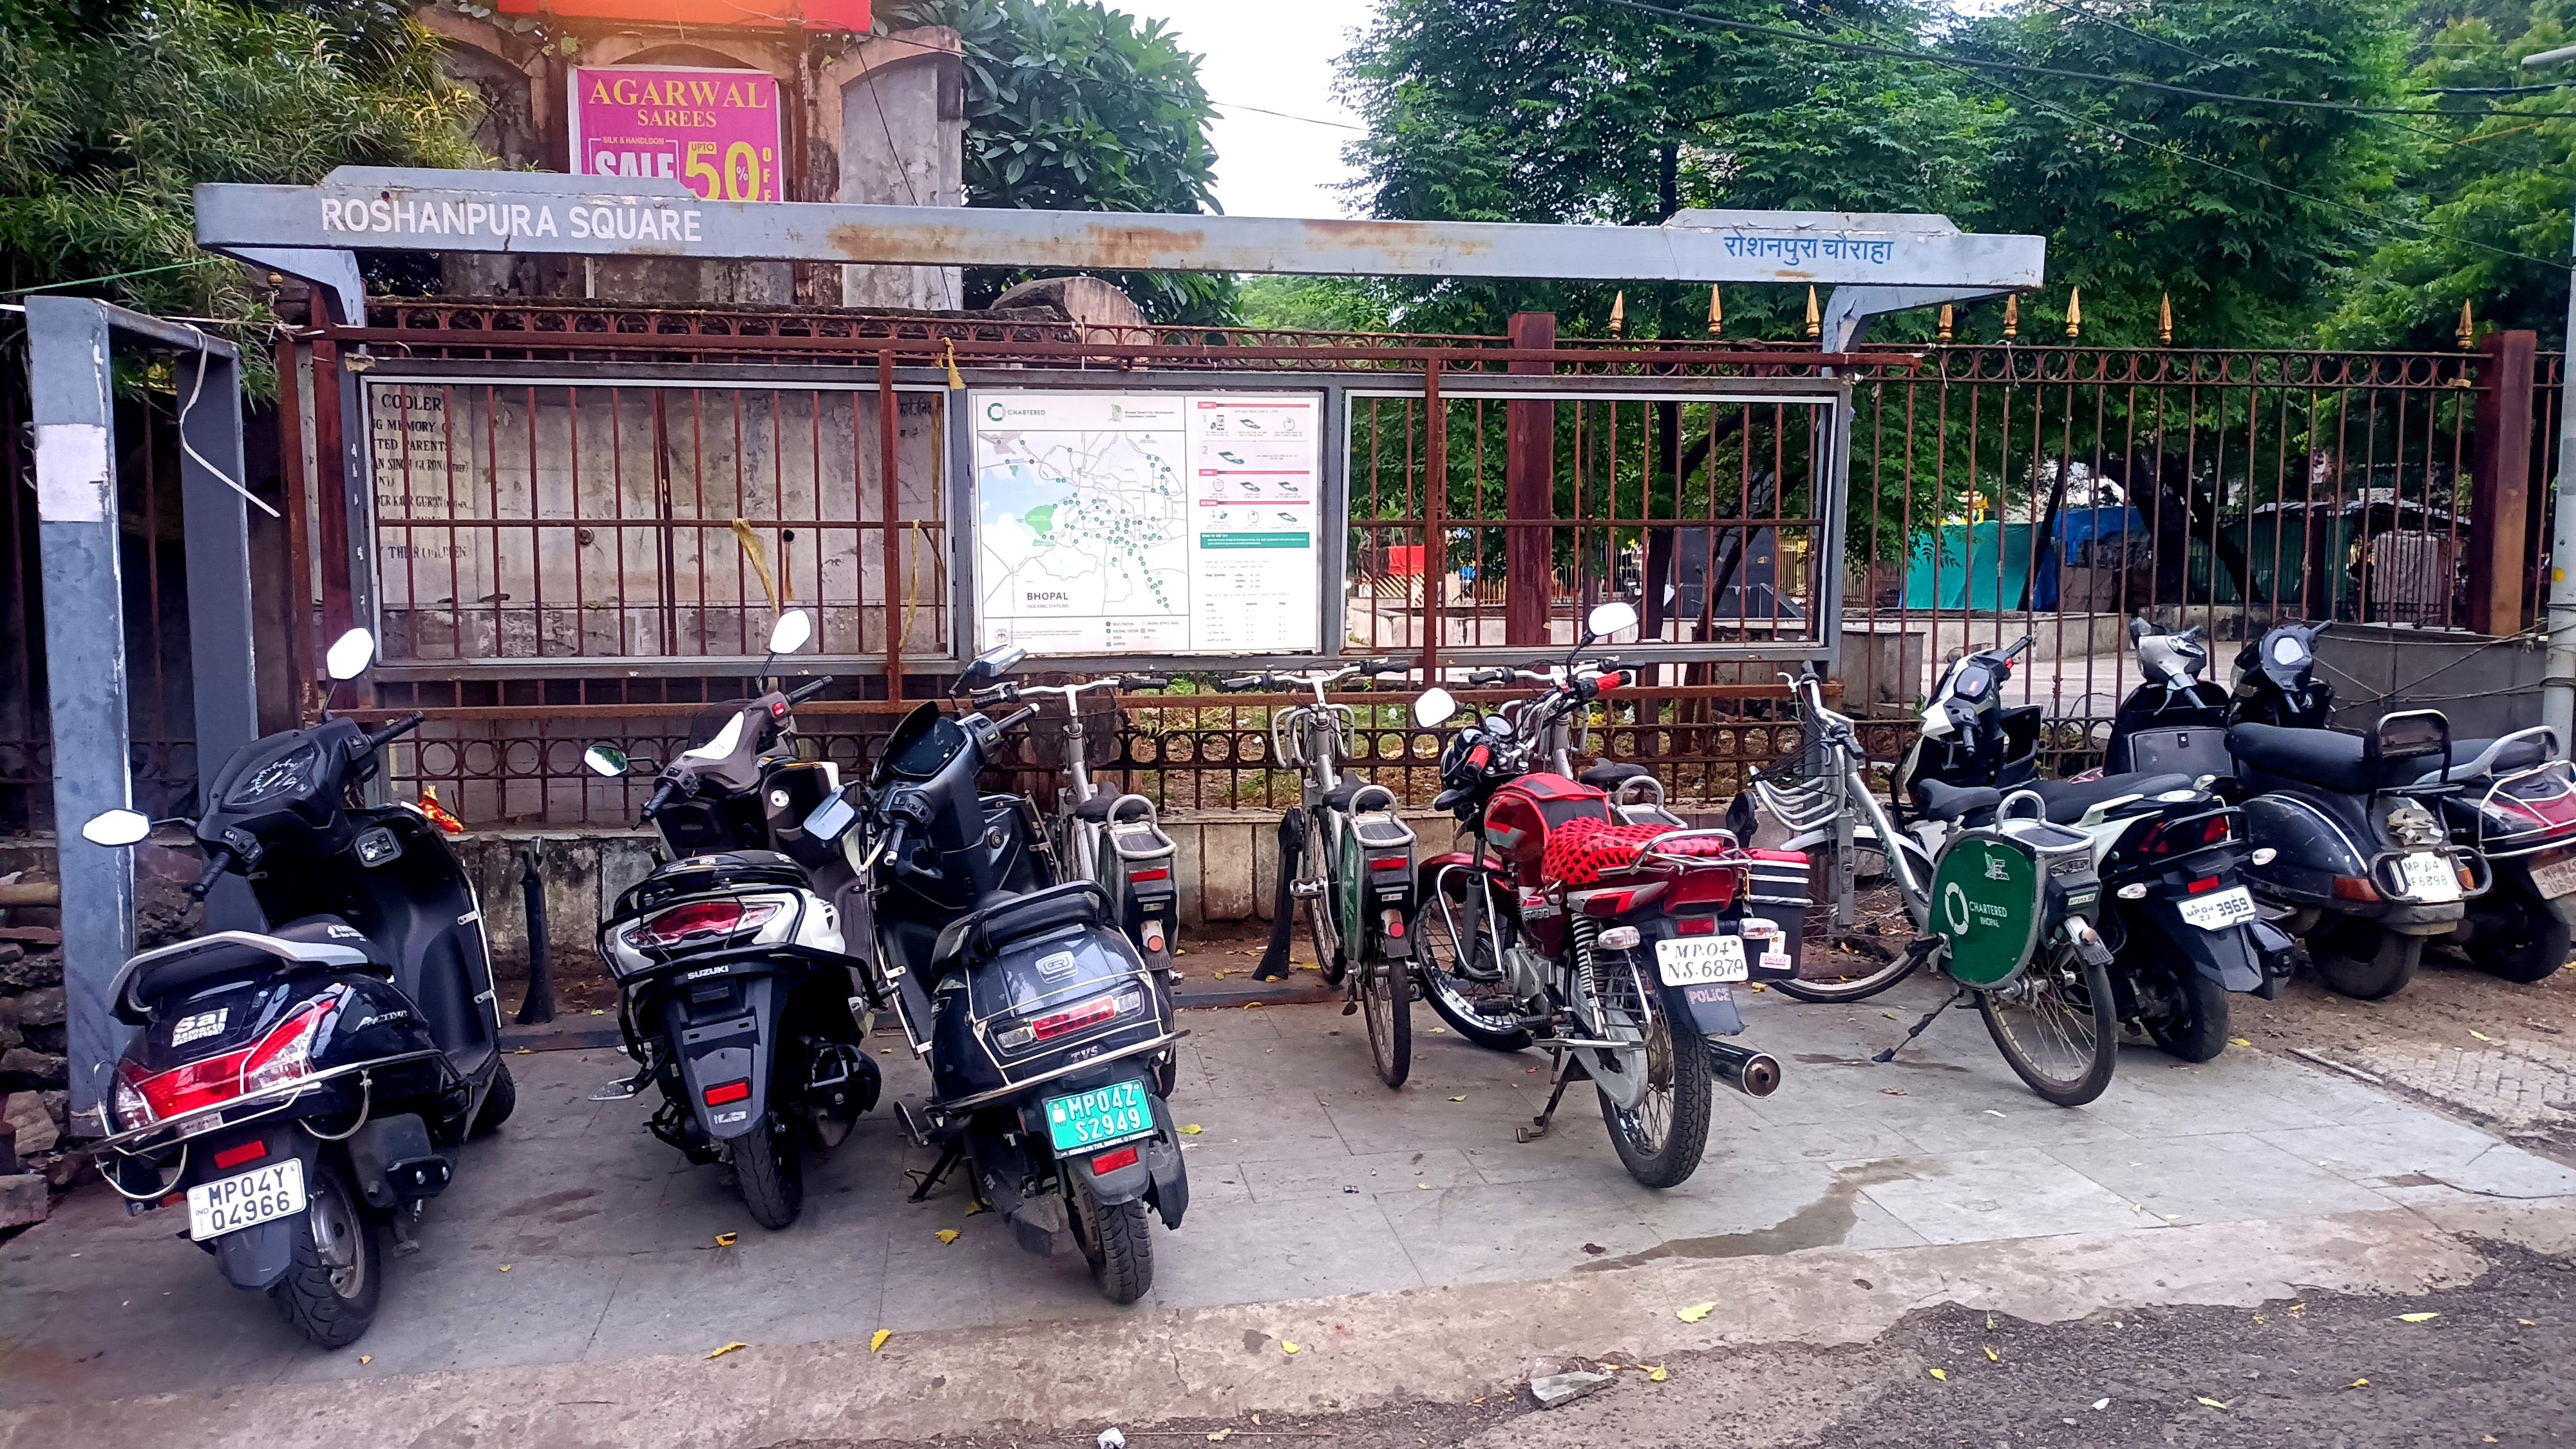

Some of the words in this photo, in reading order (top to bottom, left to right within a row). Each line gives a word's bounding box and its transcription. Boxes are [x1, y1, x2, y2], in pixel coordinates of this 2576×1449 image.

[589, 79, 768, 108] AGARWAL
[638, 109, 716, 128] SAREES
[691, 144, 715, 152] UPTO
[321, 198, 558, 238] ROSHANPURA
[569, 206, 703, 242] SQUARE
[1723, 228, 1818, 266] रोशनपुरा
[1202, 446, 1208, 455] 2
[1969, 901, 2008, 918] CHARTERED
[2216, 897, 2249, 916] 3969
[1979, 916, 2000, 928] BHOPAL
[687, 965, 729, 980] SUZUKI
[1688, 987, 1732, 1005] POLICE
[1070, 1045, 1099, 1063] TVS
[1065, 1083, 1137, 1121] MP04Z
[1075, 1106, 1142, 1142] S2949
[208, 1166, 284, 1208] MP04Y
